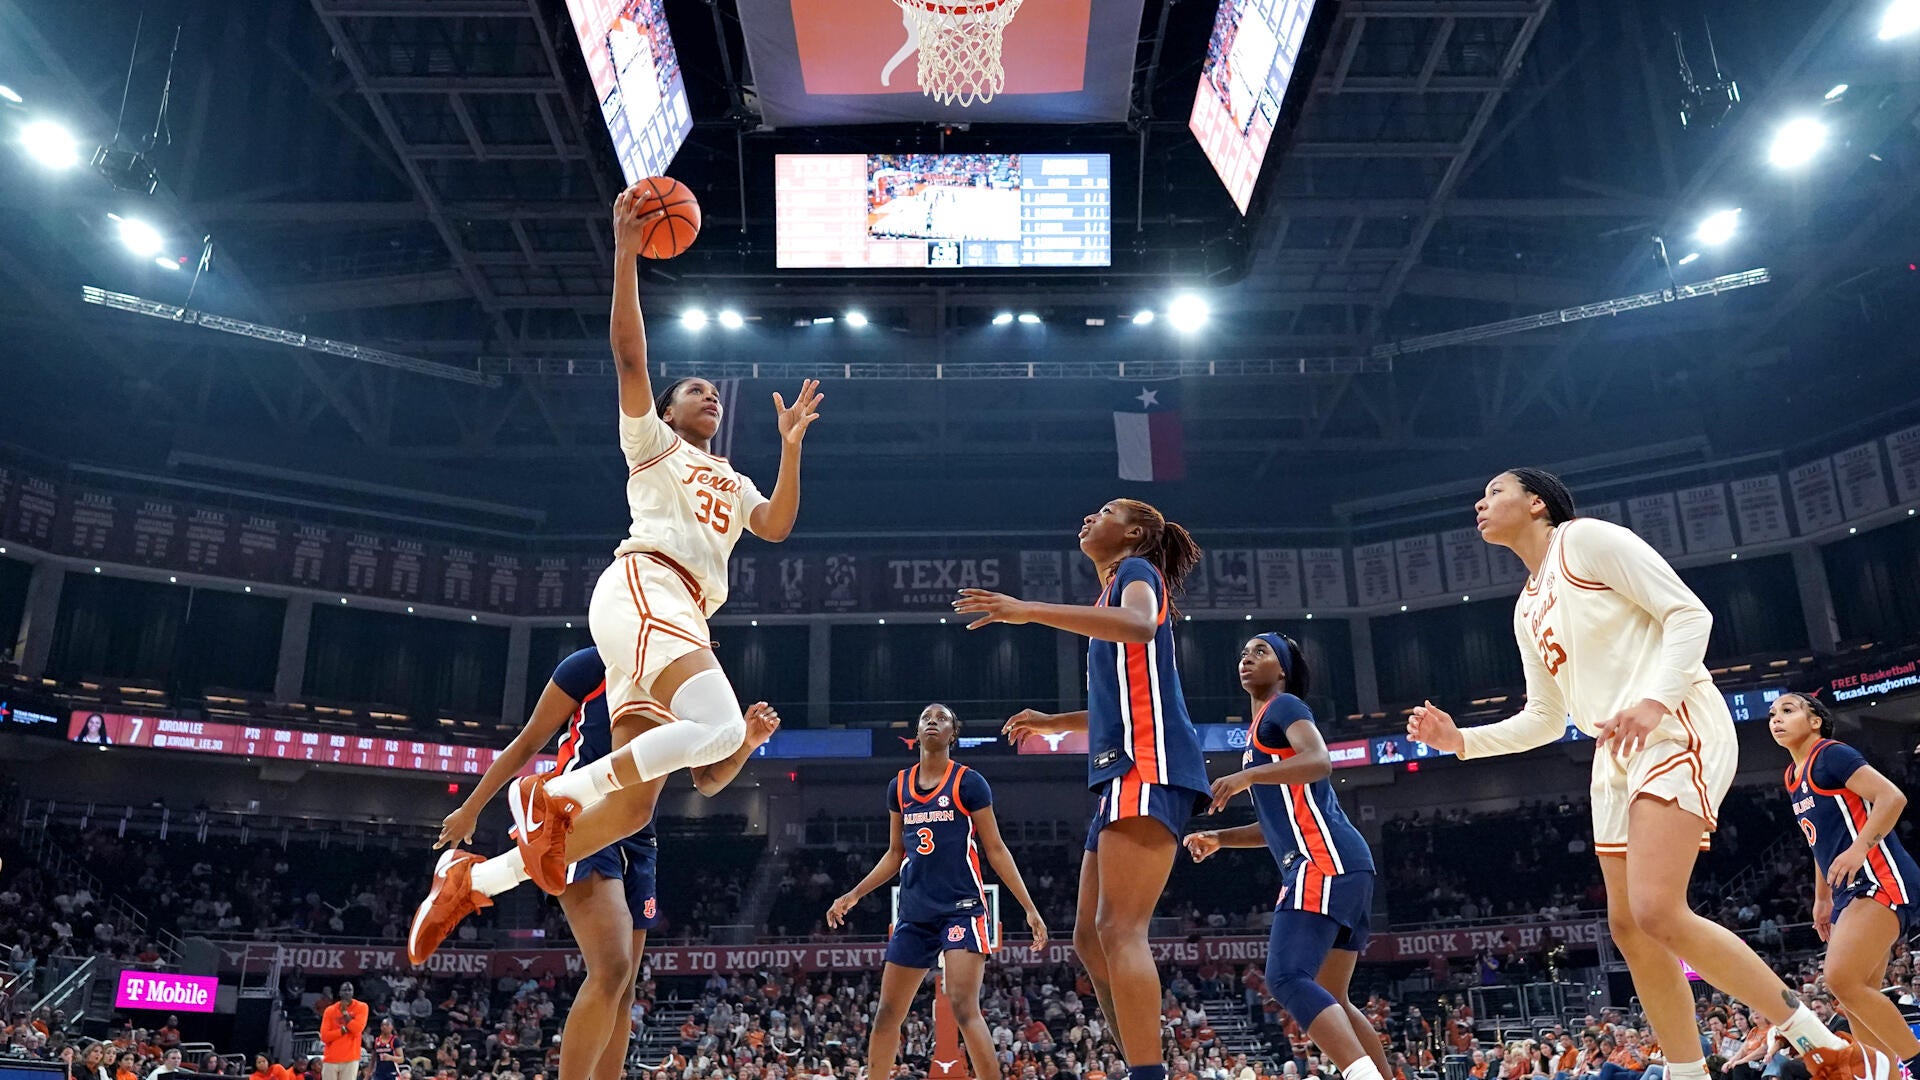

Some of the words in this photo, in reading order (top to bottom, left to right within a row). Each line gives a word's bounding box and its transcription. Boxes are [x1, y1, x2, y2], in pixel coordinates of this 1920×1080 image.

[694, 489, 732, 535] 35
[888, 558, 1000, 589] TEXAS
[1831, 675, 1859, 690] FREE
[1860, 661, 1916, 683] Basketball
[1734, 694, 1744, 706] FT
[1735, 708, 1749, 720] 1-3
[129, 718, 143, 744] 7
[157, 720, 189, 734] JORDAN
[190, 723, 204, 735] LEE
[245, 727, 261, 740] PTS
[247, 742, 255, 754] 3
[306, 747, 313, 759] 2
[333, 749, 340, 762] 2
[362, 751, 367, 764] 1
[388, 754, 395, 767] 0
[415, 756, 422, 769] 0
[441, 758, 448, 771] 0
[904, 810, 954, 825] AUBURN
[916, 827, 935, 855] 3
[279, 948, 346, 970] HOOK
[688, 951, 717, 970] TO
[726, 949, 808, 970] MOODY
[1050, 945, 1075, 964] OF
[145, 979, 208, 1005] Mobile
